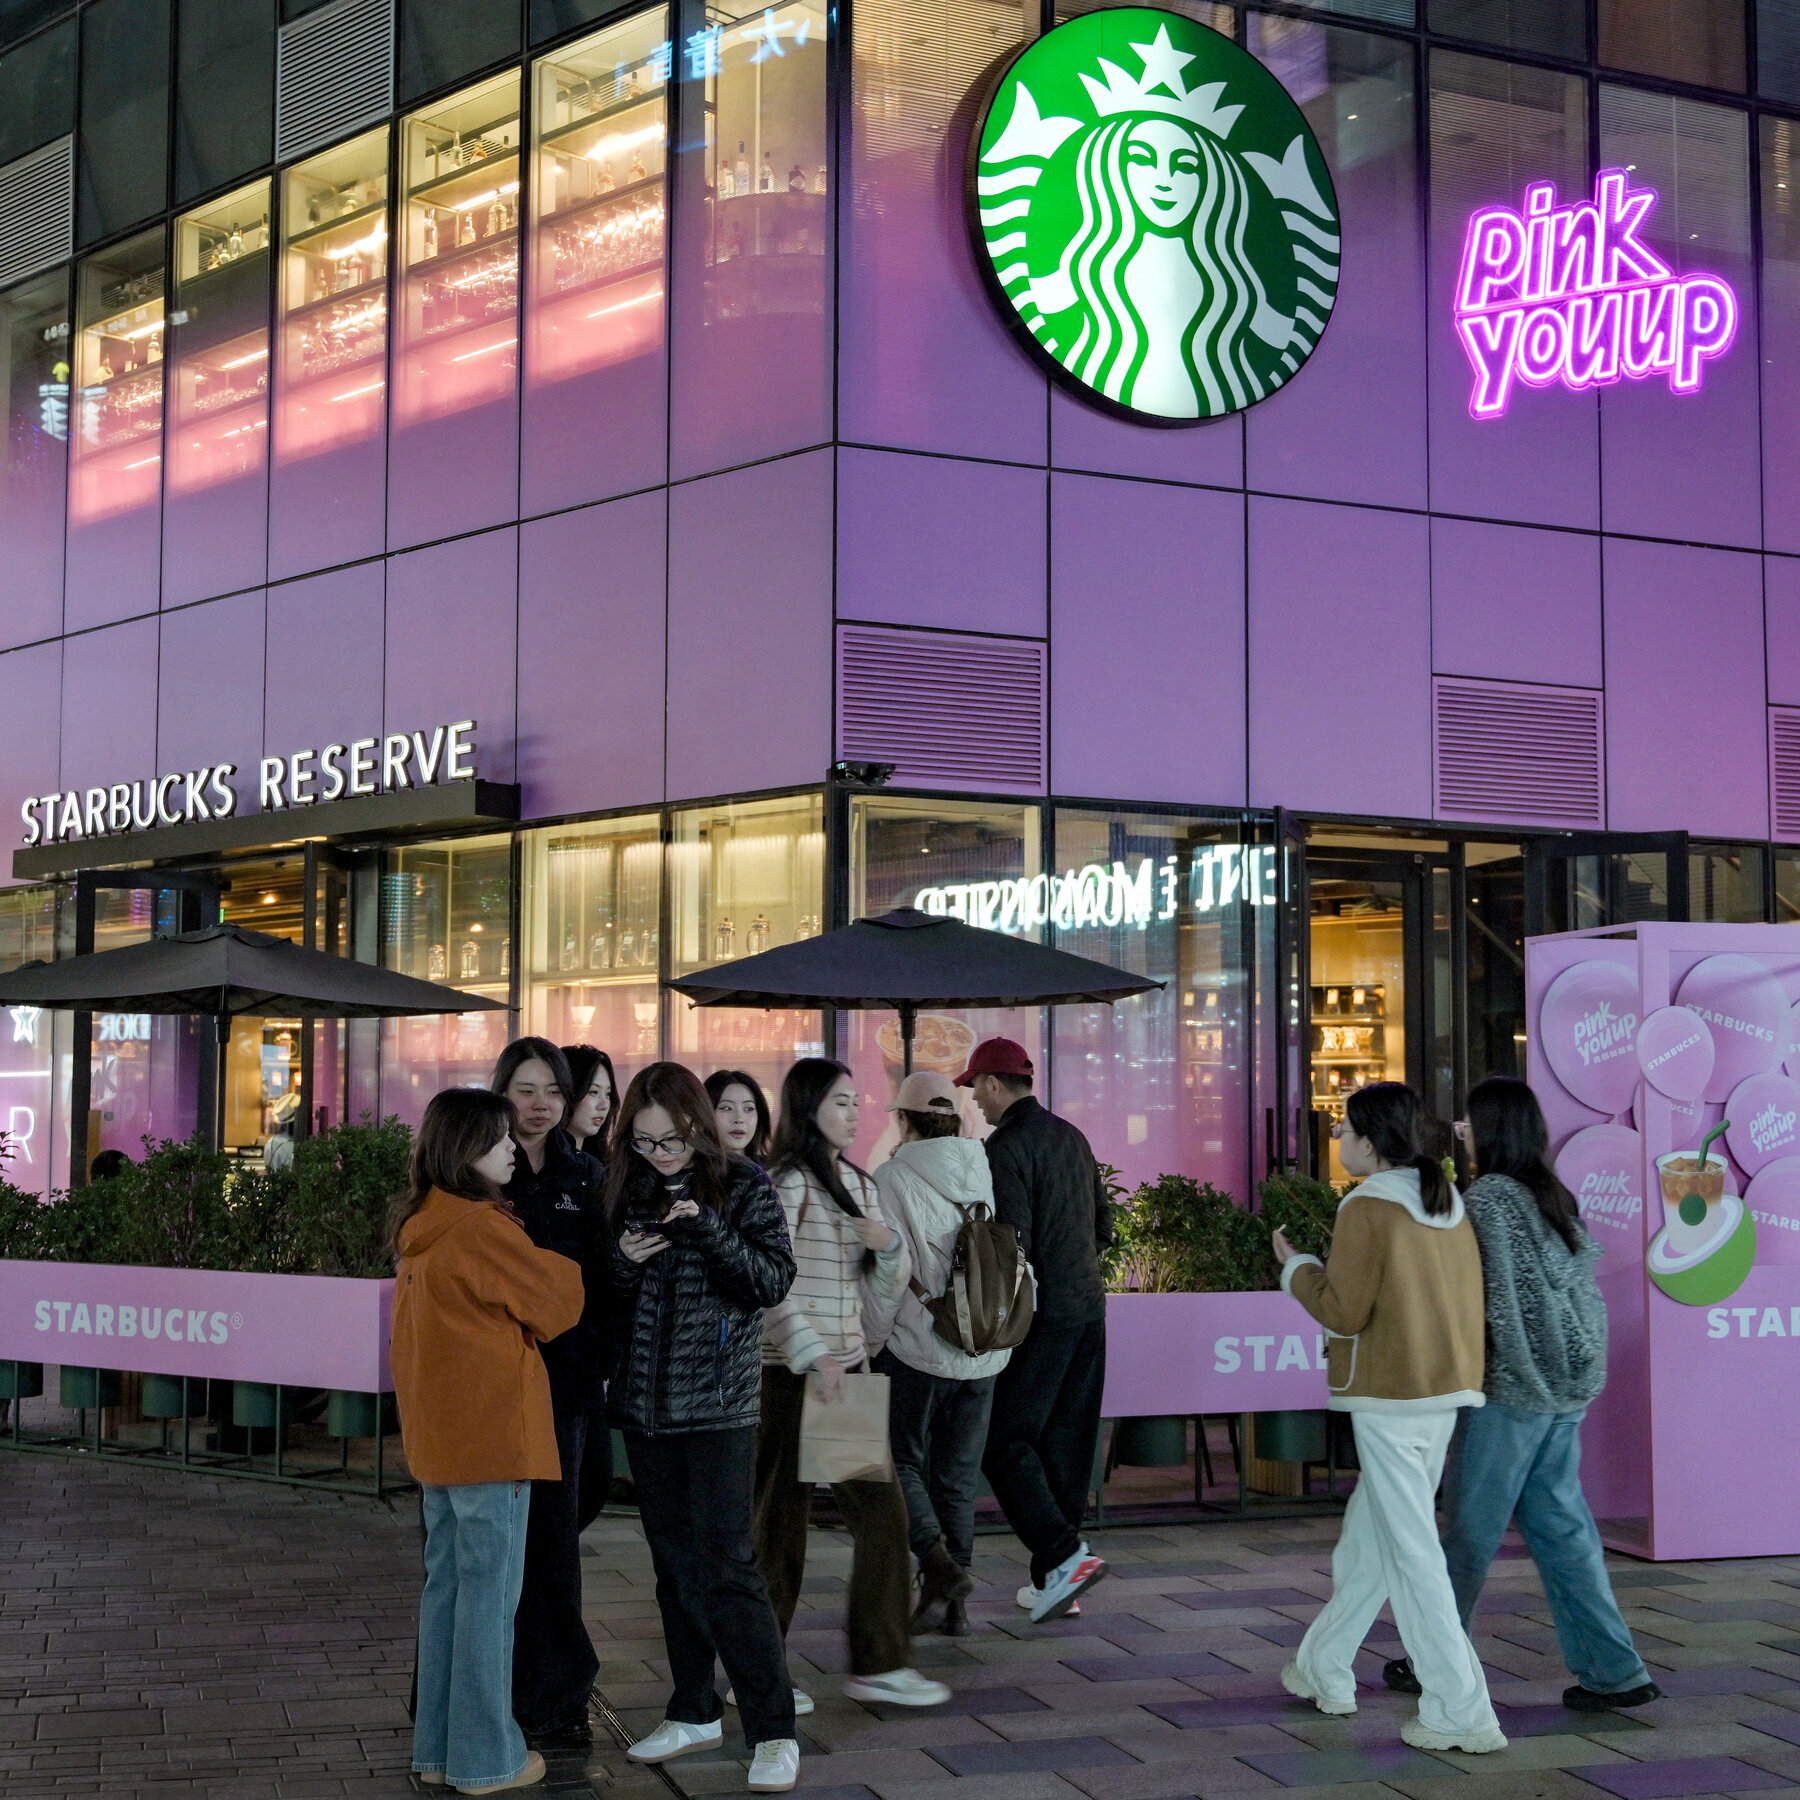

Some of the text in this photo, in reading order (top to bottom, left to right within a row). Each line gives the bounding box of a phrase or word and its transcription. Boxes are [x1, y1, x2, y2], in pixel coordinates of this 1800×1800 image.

[1459, 172, 1672, 312] pink
[21, 719, 478, 848] STARBUCKS RESERVE
[1574, 1000, 1619, 1047] pink
[1647, 1033, 1701, 1071] STARBUCKS
[1750, 1103, 1783, 1139] pink
[1579, 1169, 1631, 1194] pink
[554, 1202, 580, 1211] CAMEL
